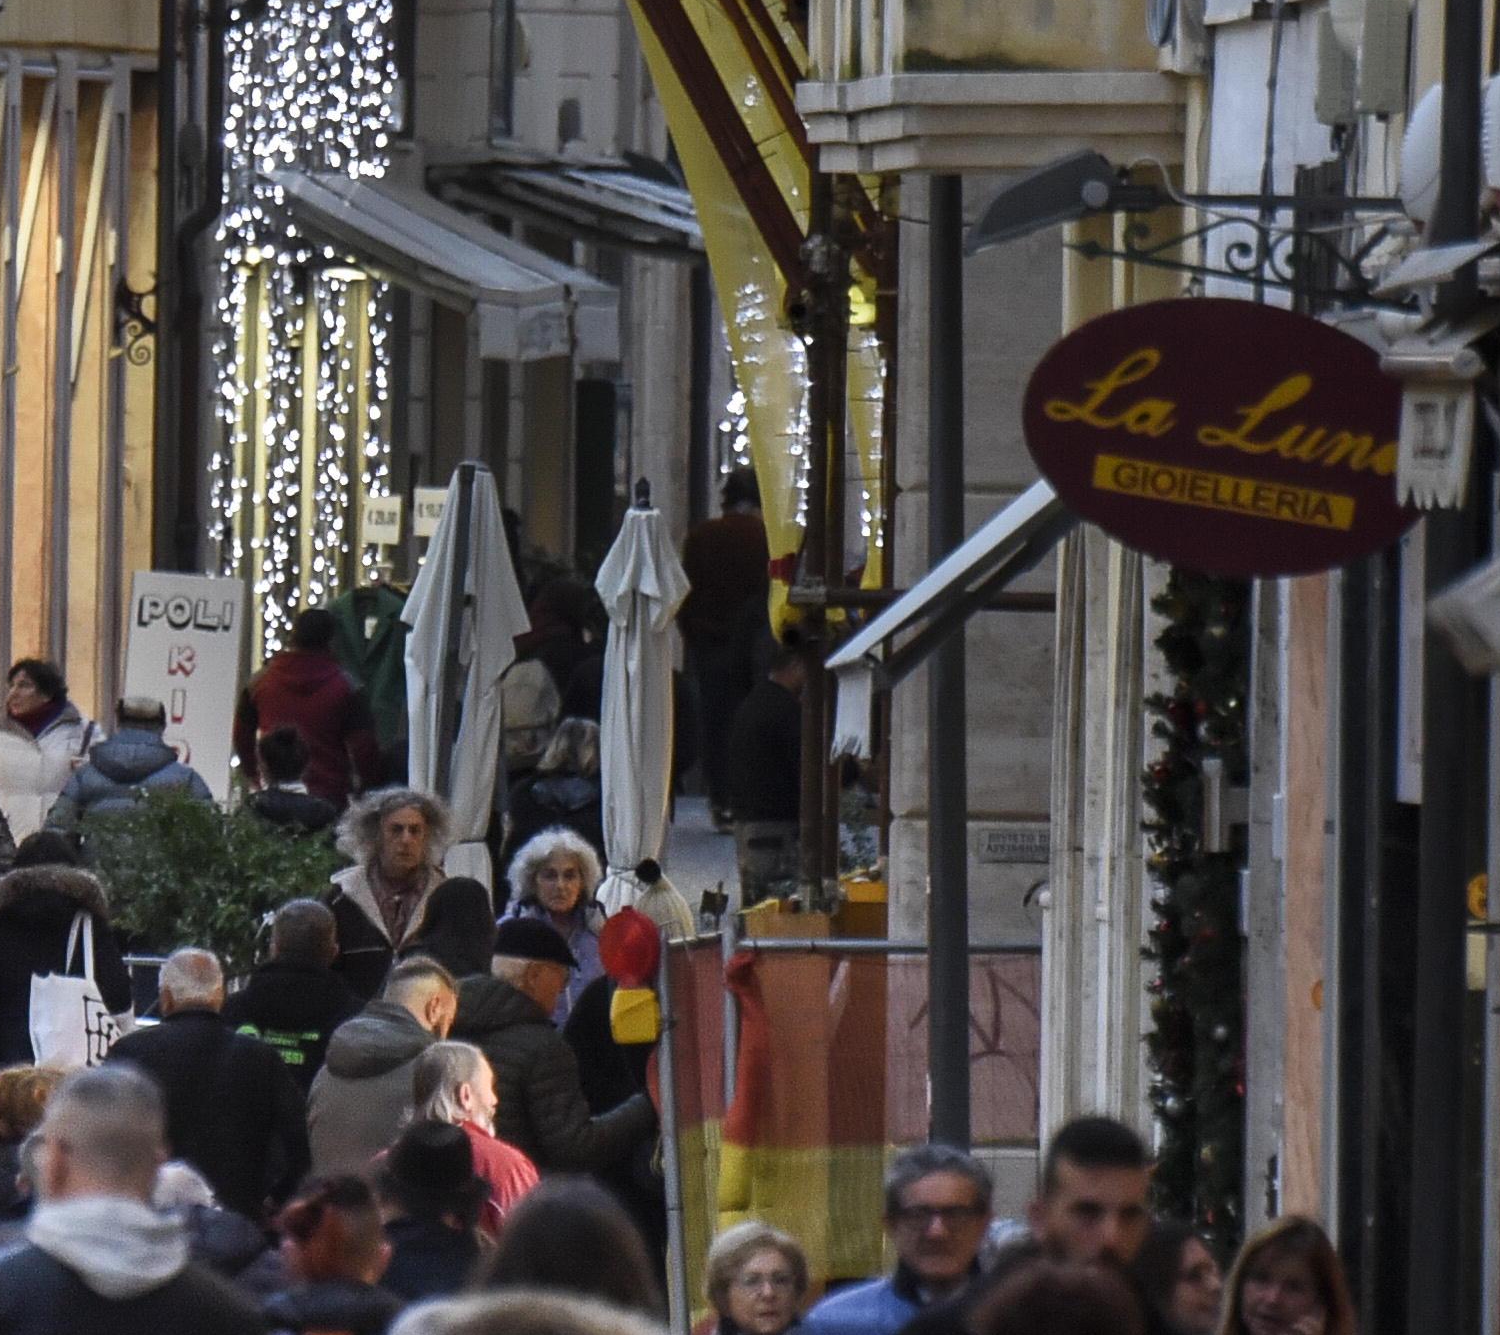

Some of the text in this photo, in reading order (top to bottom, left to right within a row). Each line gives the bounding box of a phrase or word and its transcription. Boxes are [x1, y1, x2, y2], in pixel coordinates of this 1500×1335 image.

[1044, 348, 1178, 437] La
[1113, 464, 1334, 523] GIOIELLERIA
[137, 594, 234, 632] POLI
